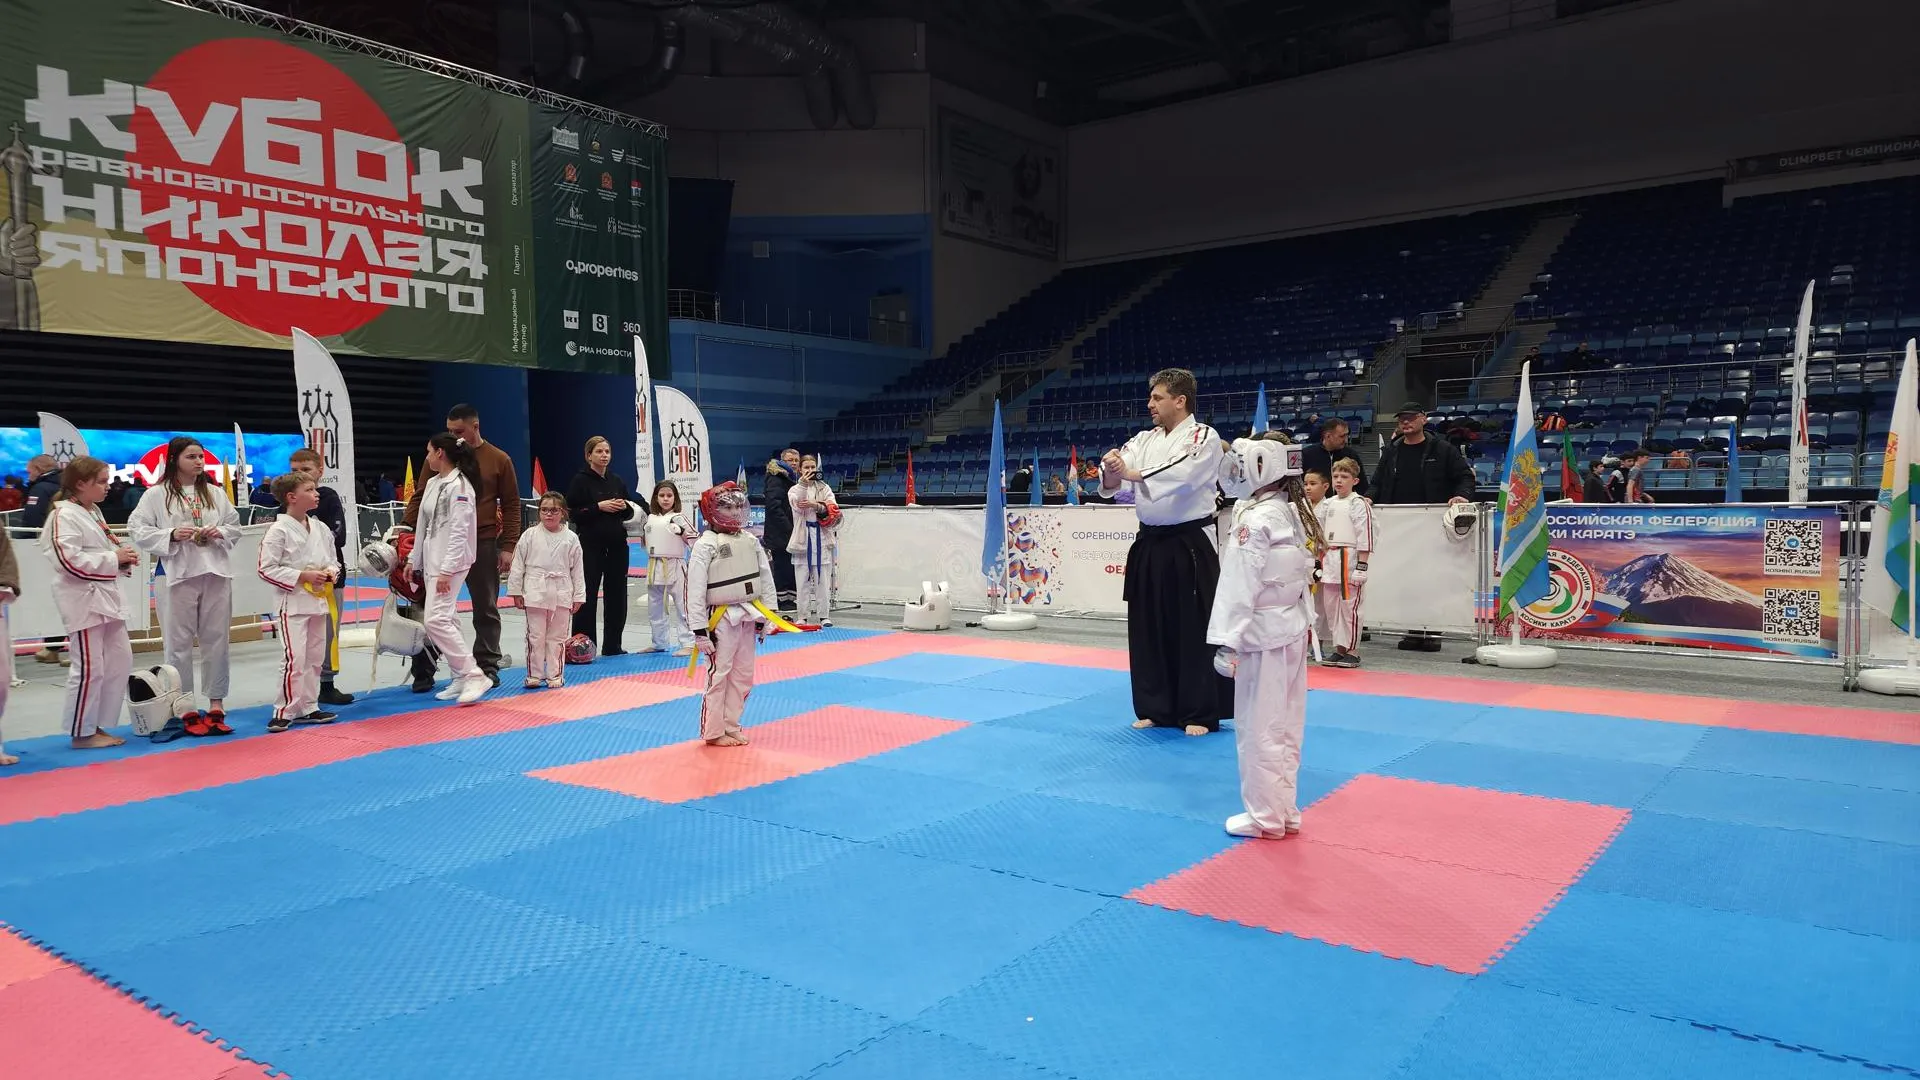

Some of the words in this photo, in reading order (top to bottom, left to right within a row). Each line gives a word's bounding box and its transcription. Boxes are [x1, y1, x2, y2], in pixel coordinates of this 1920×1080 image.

[623, 321, 641, 333] 360
[579, 345, 595, 354] РИА
[596, 348, 632, 358] НОВОСТИ
[1547, 513, 1643, 525] ОССИЙСКАЯ
[1648, 515, 1757, 527] ФЕДЕРАЦИЯ
[1072, 531, 1135, 541] СОРЕВНОВА
[1572, 530, 1636, 540] КАРАТЭ
[1072, 549, 1128, 561] ВСЕРОСС
[1104, 564, 1126, 576] ФЕ
[1561, 555, 1591, 591] ФЕДЕРАЦИЯ
[1520, 612, 1547, 628] КОСИКИ
[1550, 615, 1577, 628] КАРАТЭ
